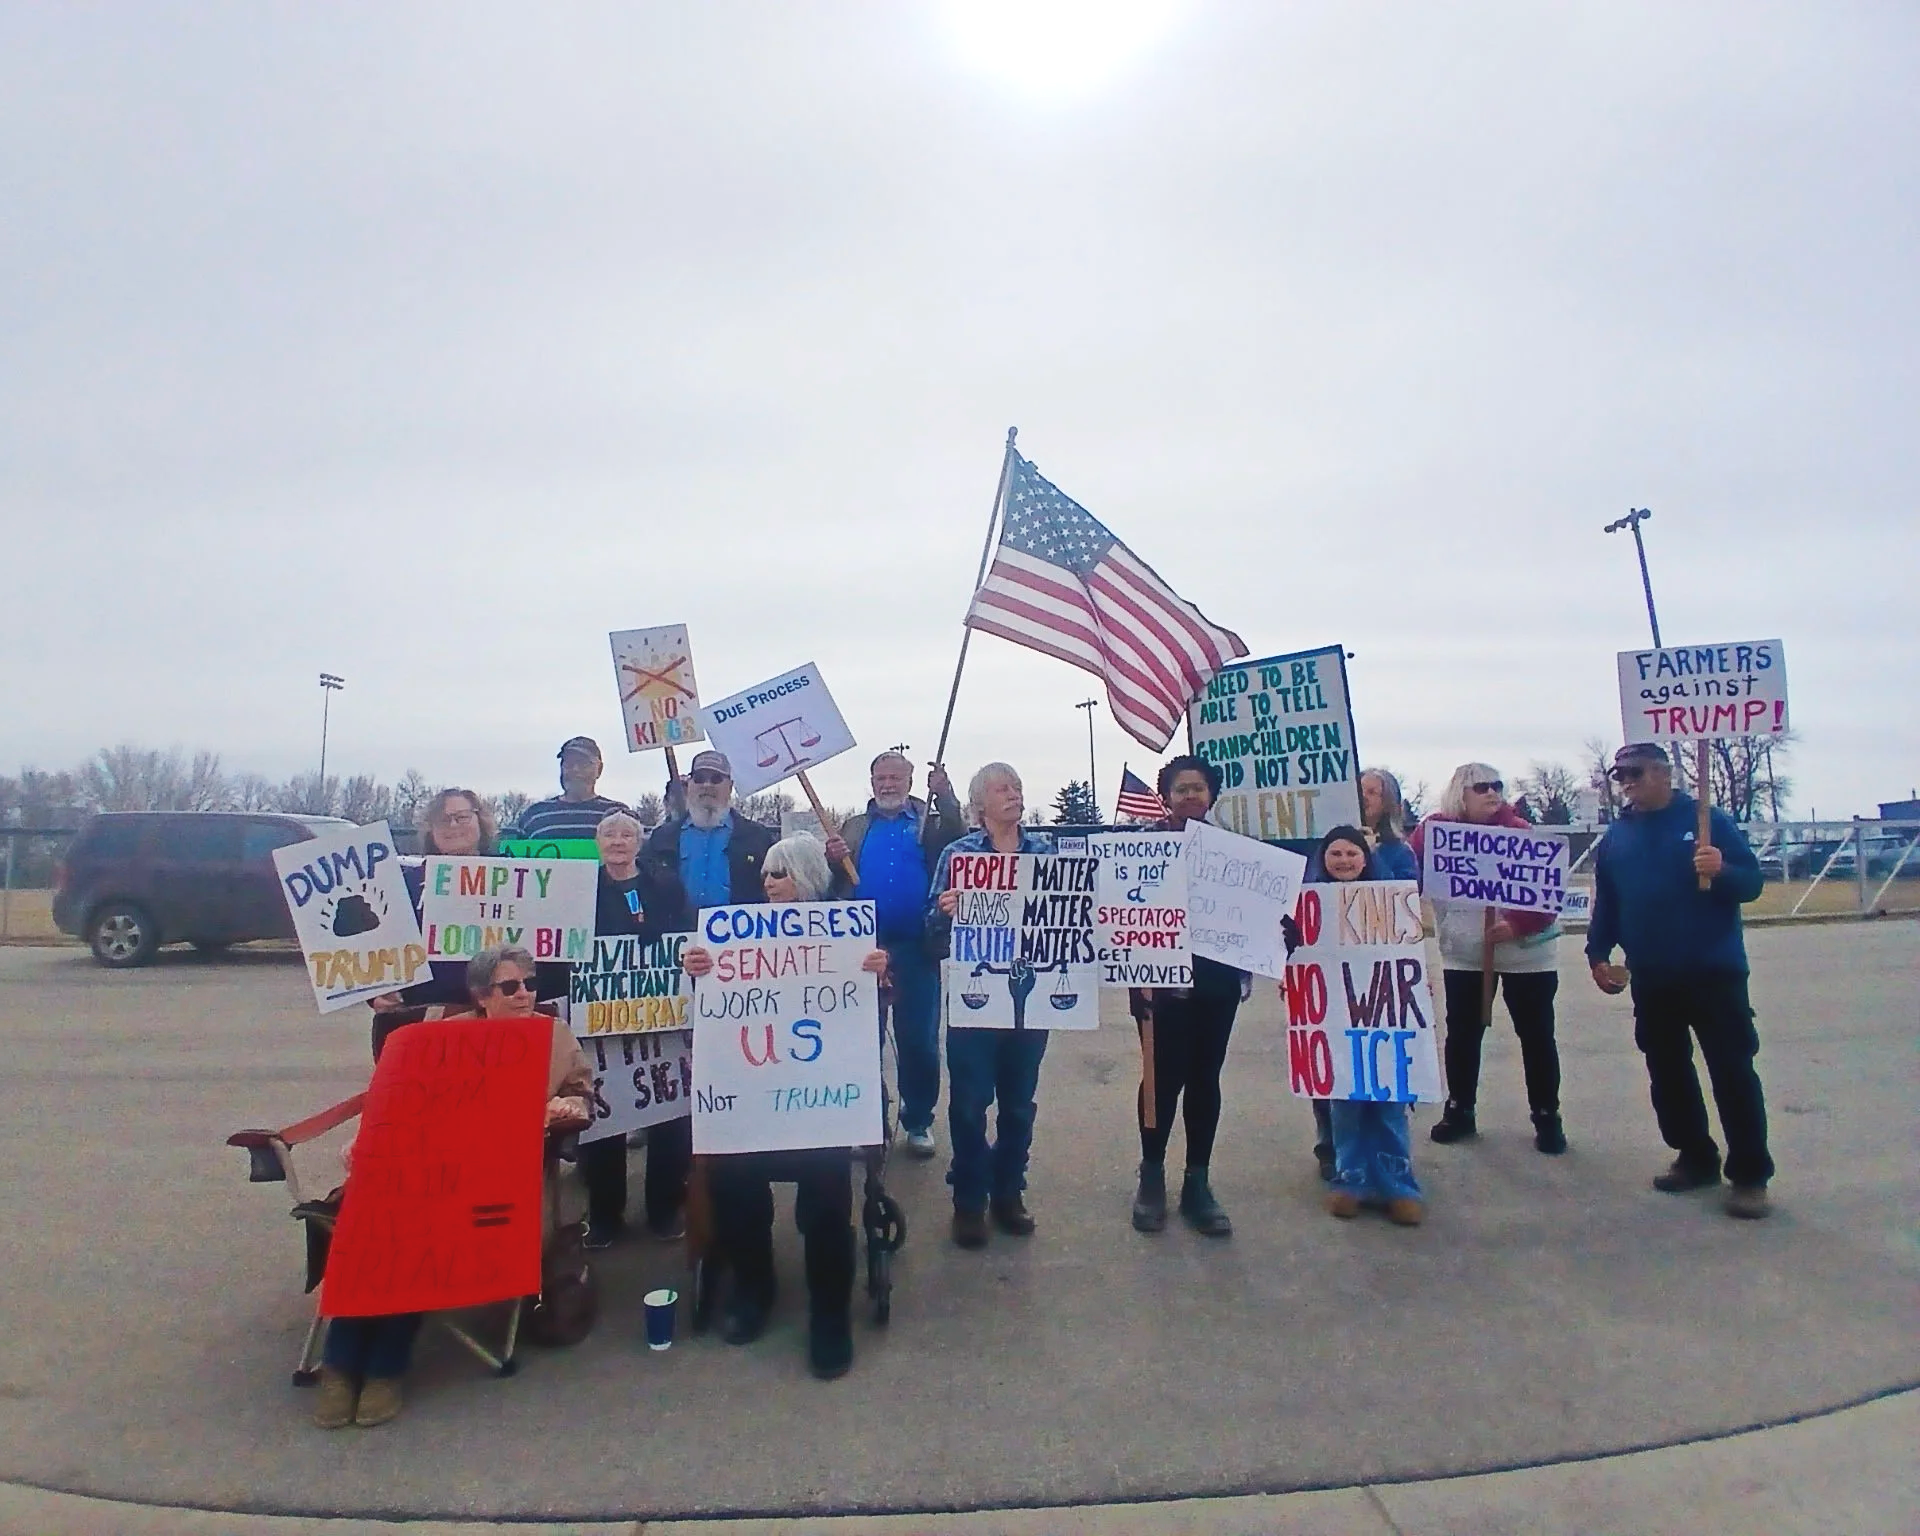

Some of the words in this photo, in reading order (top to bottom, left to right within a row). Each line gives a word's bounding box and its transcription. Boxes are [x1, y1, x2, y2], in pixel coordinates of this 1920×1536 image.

[1207, 670, 1249, 700] NEED
[1258, 665, 1282, 690] TO
[1291, 660, 1319, 686] BE
[1636, 645, 1772, 680] FARMERS
[713, 702, 747, 724] DUE
[746, 675, 811, 709] PROCESS
[1200, 697, 1238, 724] ABLE
[1248, 691, 1271, 717] TO
[1276, 684, 1328, 713] TELL
[1640, 675, 1759, 704] against
[652, 696, 678, 722] NO
[1254, 714, 1278, 732] MY
[1644, 700, 1785, 735] TRUMP!
[634, 717, 697, 745] KINGS
[1196, 722, 1342, 761] GRANDCHILDREN
[1254, 756, 1289, 788] NOT
[1298, 750, 1349, 785] STAY
[1091, 841, 1182, 858] DEMOCRACY
[1433, 826, 1565, 865] DEMOCRACY
[284, 842, 390, 907] DUMP
[435, 863, 553, 898] EMPTY
[951, 855, 1020, 890] PEOPLE
[1032, 856, 1100, 892] MATTER
[1114, 862, 1128, 880] is
[1138, 860, 1169, 882] not
[1433, 854, 1479, 876] DIES
[1496, 861, 1561, 887] WITH
[479, 902, 516, 920] THE
[705, 904, 876, 944] CONGRESS
[957, 891, 1011, 926] LAWS
[1022, 894, 1093, 927] MATTER
[1098, 906, 1186, 928] SPECTATOR
[536, 927, 589, 959] BIN
[953, 926, 1016, 962] TRUTH
[1020, 928, 1096, 964] MATTERS
[1098, 948, 1131, 962] GET
[1110, 930, 1184, 950] SPORT.
[1190, 928, 1249, 952] anger
[308, 943, 427, 990] TRUMP
[716, 944, 838, 983] SENATE
[1104, 963, 1193, 984] INVOLVED
[571, 968, 683, 1004] PARTICIPANT
[700, 987, 781, 1019] WORK
[803, 980, 859, 1014] FOR
[1285, 963, 1328, 1027] NO
[1341, 959, 1427, 1029] WAR
[1289, 1029, 1335, 1097] NO
[1344, 1028, 1419, 1103] ICE
[766, 1083, 861, 1112] TRUMP
